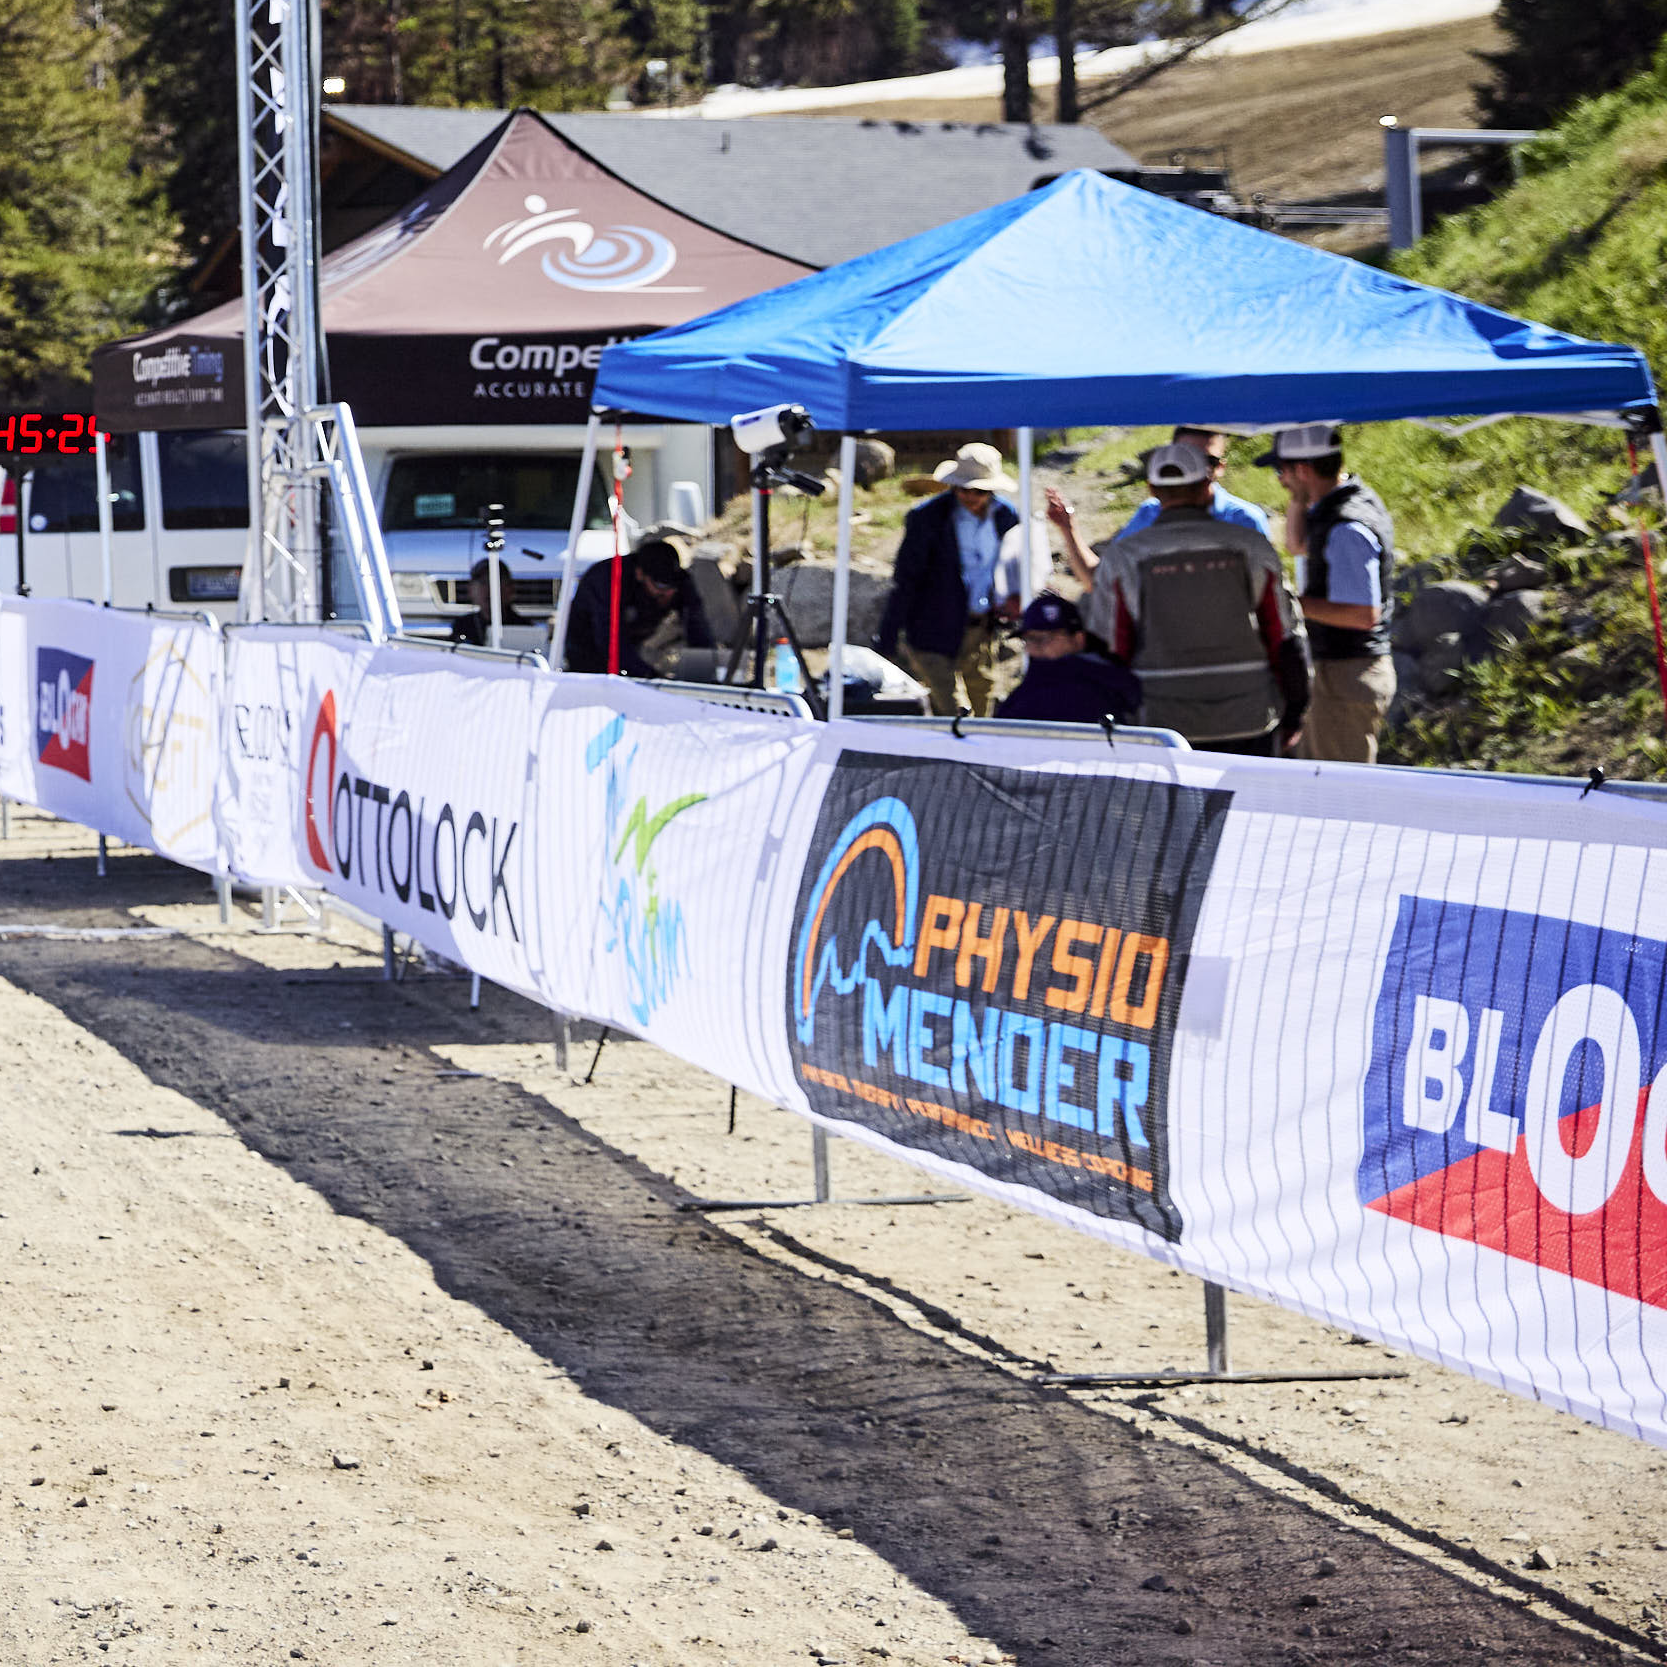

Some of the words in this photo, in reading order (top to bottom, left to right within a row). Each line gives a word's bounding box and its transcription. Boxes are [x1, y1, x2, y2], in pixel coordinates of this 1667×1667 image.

[470, 336, 639, 378] Compe
[473, 382, 587, 398] ACCURATE
[333, 771, 520, 943] OTTOLOCK
[913, 893, 1170, 1030] PHYSIO
[862, 977, 1151, 1148] MENDER
